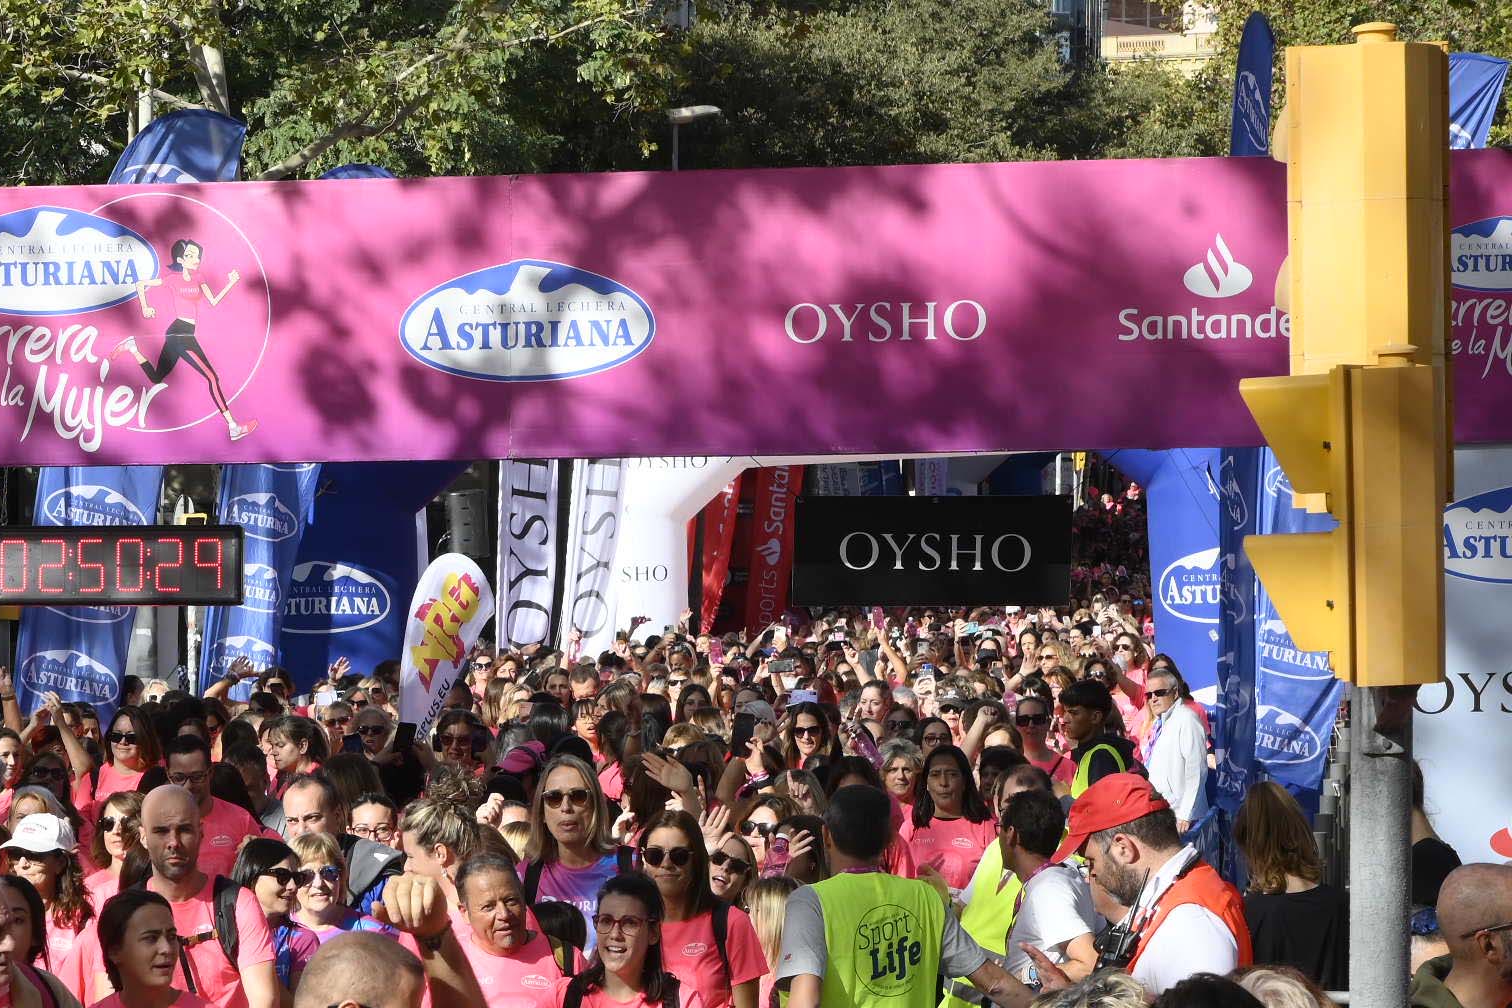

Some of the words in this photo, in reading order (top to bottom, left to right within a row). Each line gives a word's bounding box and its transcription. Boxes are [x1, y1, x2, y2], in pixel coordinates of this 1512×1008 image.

[459, 303, 538, 315] CENTRAL
[546, 301, 627, 313] LECHERA
[784, 299, 988, 344] OYSHO
[1118, 306, 1290, 341] Santande
[420, 306, 636, 352] ASTURIANA
[1468, 327, 1487, 355] la
[0, 367, 26, 407] la
[20, 357, 169, 453] Mujer
[0, 538, 223, 593] 02:50:29
[506, 459, 550, 648] OYSH
[571, 459, 622, 639] OYSH
[839, 531, 1033, 572] OYSHO
[328, 585, 377, 594] LECHERA
[621, 564, 669, 582] SHO
[1182, 573, 1221, 582] CENTR
[27, 661, 111, 698] ASTURIANA
[858, 911, 912, 951] Sport
[869, 935, 922, 981] Life
